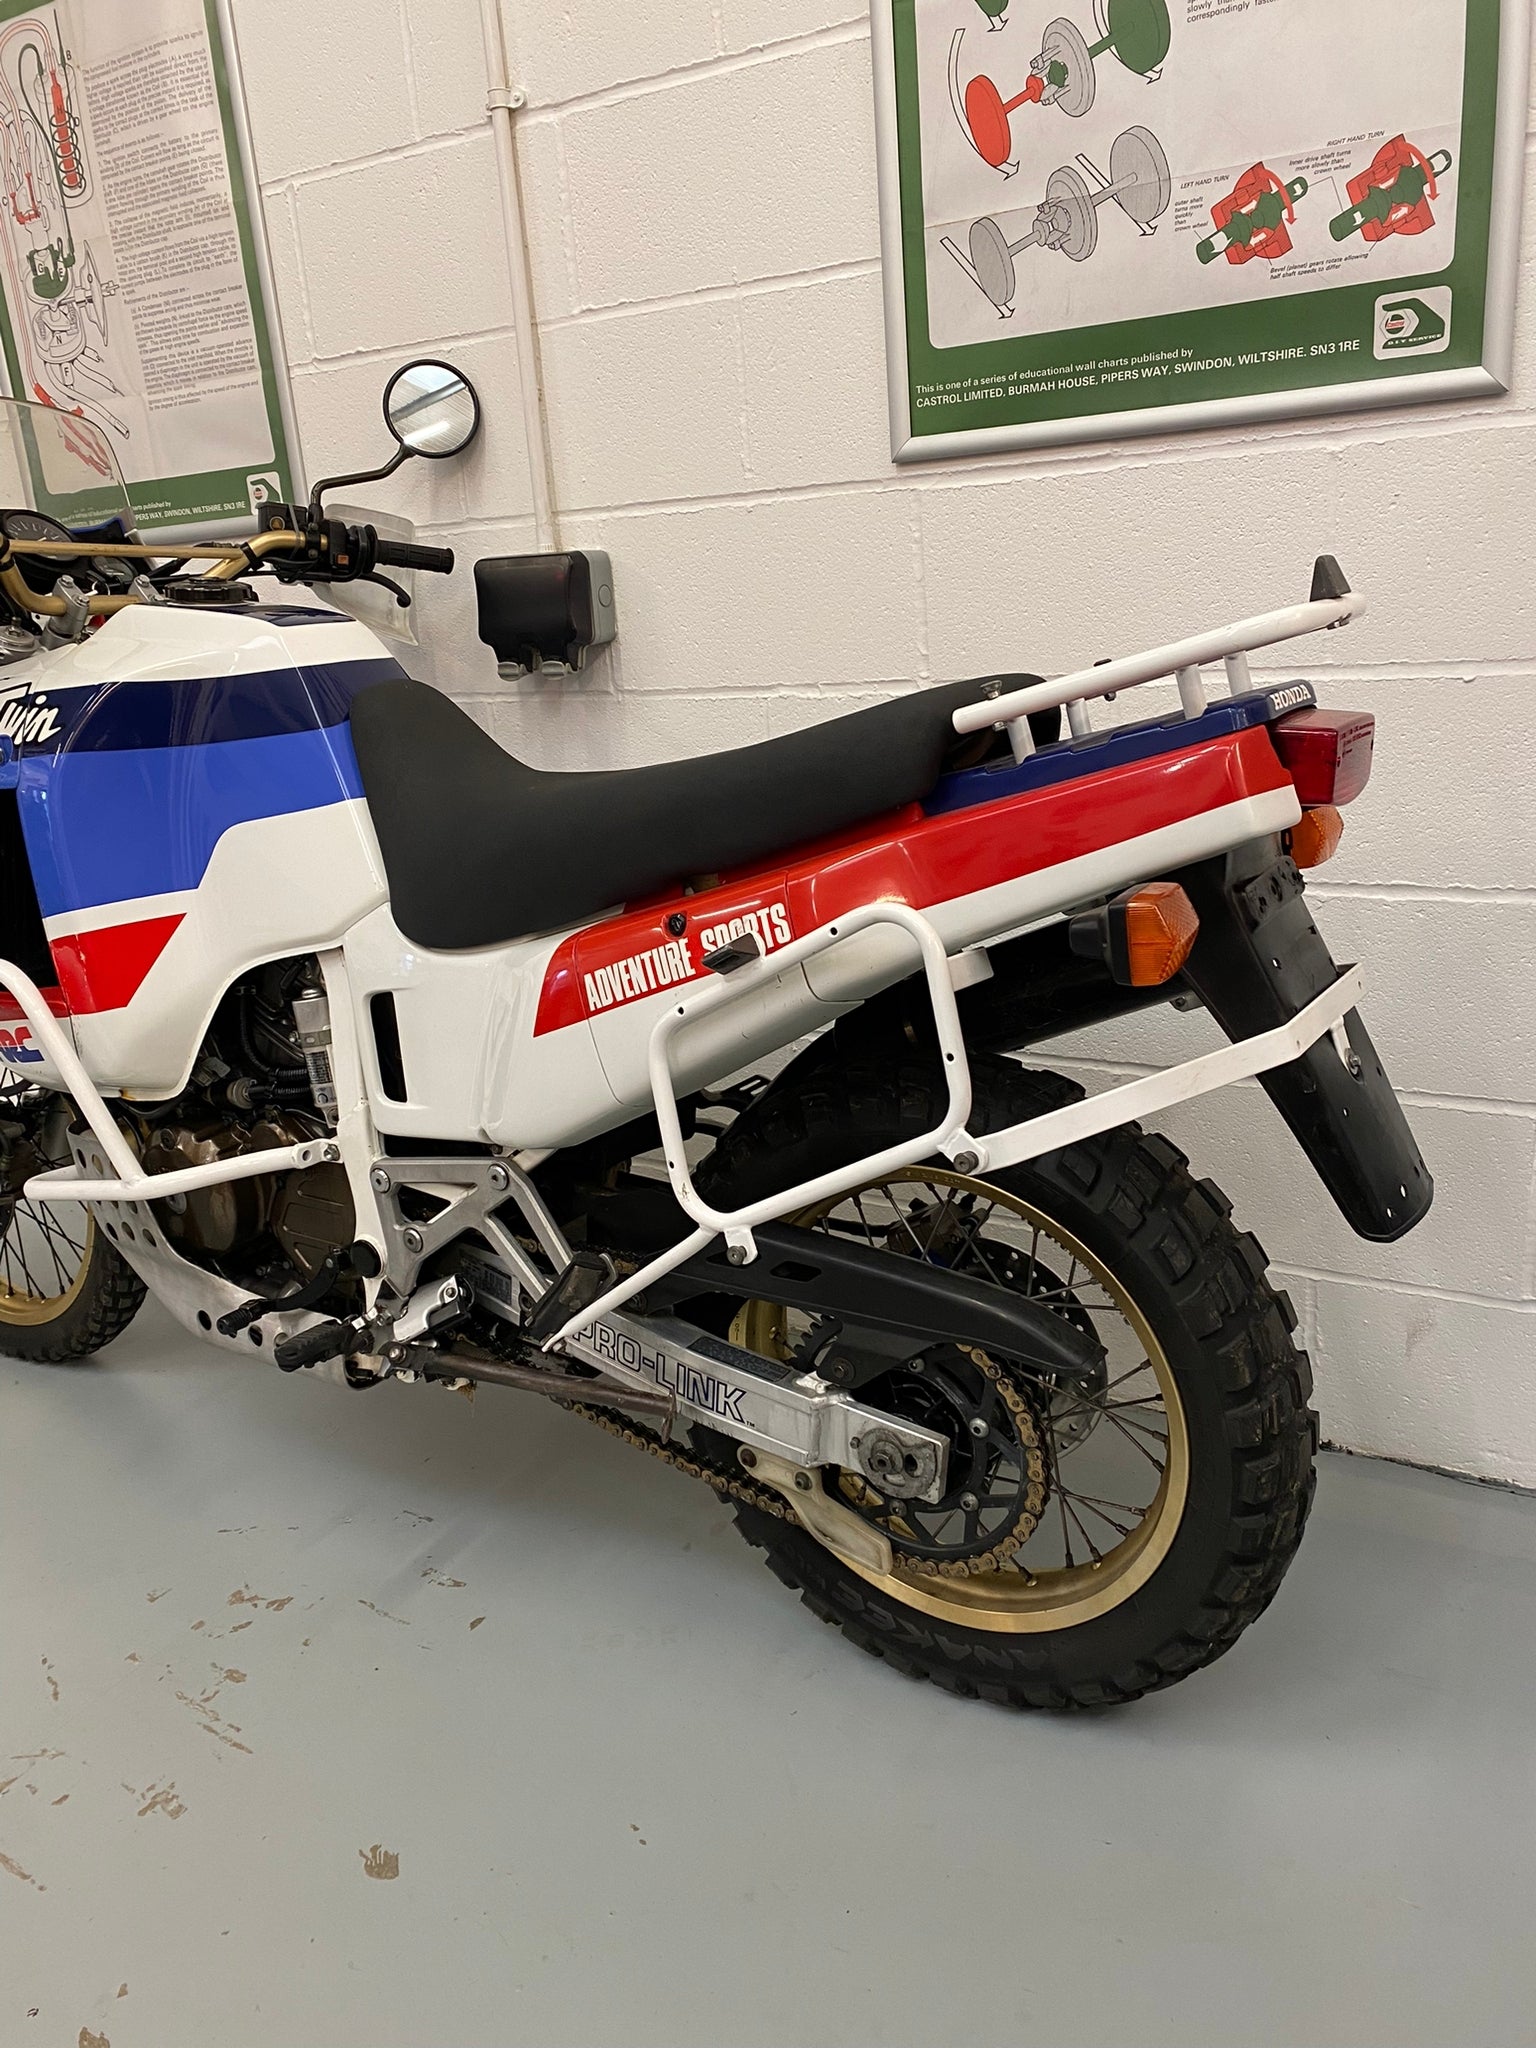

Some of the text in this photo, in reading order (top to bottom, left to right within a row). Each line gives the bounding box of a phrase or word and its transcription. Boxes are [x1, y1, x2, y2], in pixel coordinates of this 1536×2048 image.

[1186, 1, 1250, 23] correspondingly
[1327, 130, 1385, 147] RIGHT HAND TURN
[1320, 152, 1335, 160] shaft
[1336, 149, 1351, 157] turns
[1311, 161, 1330, 169] slowly
[1333, 162, 1352, 171] wheel
[1181, 181, 1194, 189] LEFT
[1195, 178, 1212, 186] HAND
[1309, 259, 1325, 268] gears
[1344, 252, 1369, 262] allowing
[38, 263, 44, 273] G
[1282, 270, 1296, 278] shaft
[1298, 268, 1317, 276] speeds
[56, 335, 62, 344] N
[64, 367, 69, 377] F
[916, 384, 934, 394] This
[936, 382, 943, 391] is
[945, 380, 961, 390] one
[962, 378, 971, 388] of
[980, 374, 1006, 385] series
[1008, 369, 1017, 381] of
[1019, 363, 1073, 380] educational
[1074, 361, 1096, 373] wall
[1098, 357, 1129, 369] charts
[1131, 349, 1179, 366] published
[1181, 348, 1193, 357] by
[916, 393, 962, 408] CASTROL
[1008, 381, 1055, 396] BURMAH
[1058, 375, 1099, 390] HOUSE,
[1101, 368, 1139, 384] PIPERS
[1141, 364, 1172, 378] WAY,
[1174, 357, 1235, 374] SWINDON,
[1310, 342, 1336, 356] SN3
[1338, 339, 1360, 352] 1RE
[1270, 684, 1311, 711] HONDA
[584, 939, 696, 1011] ADVENTURE
